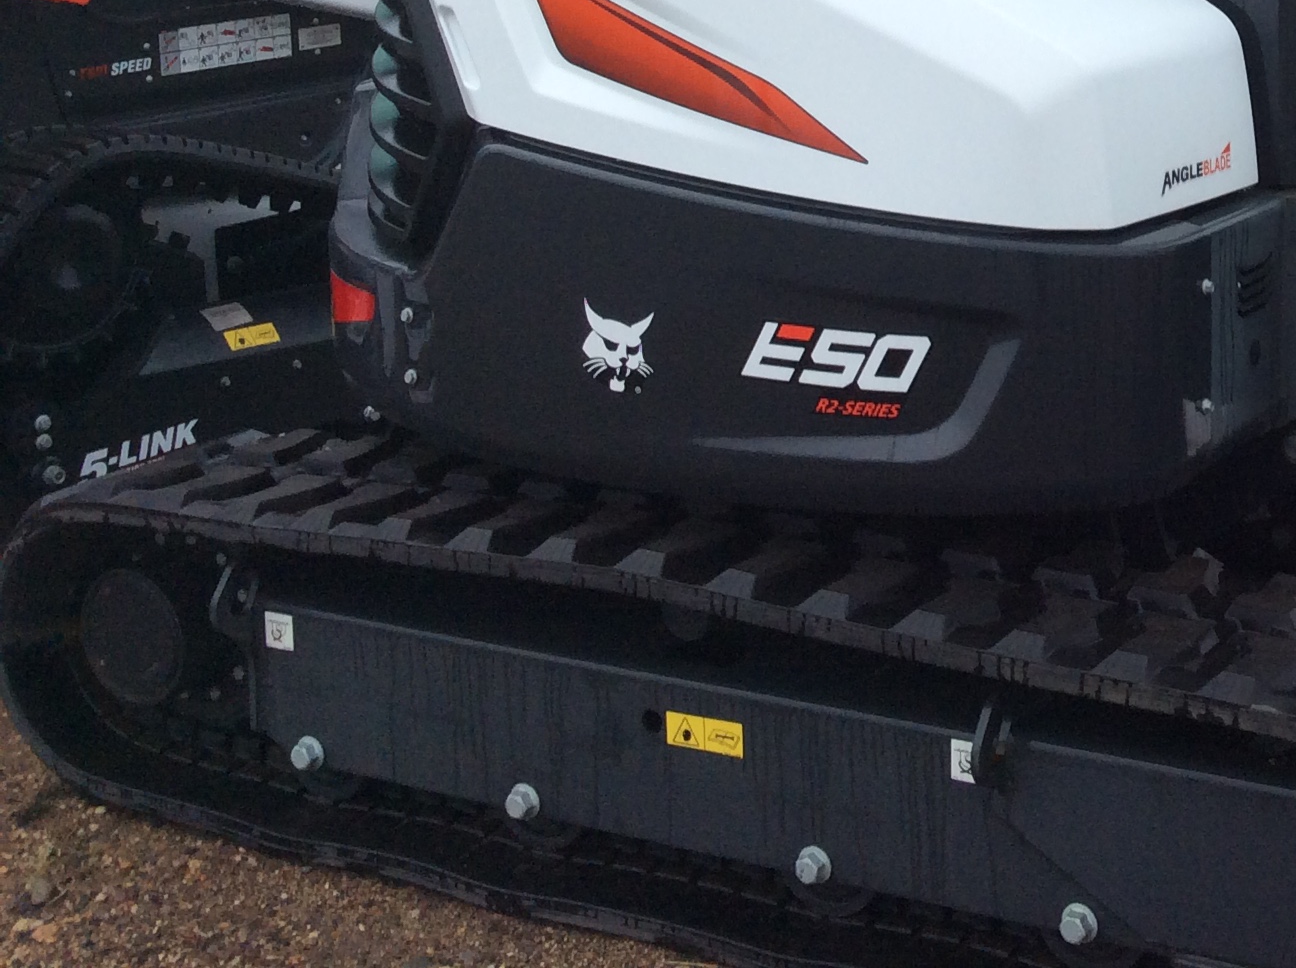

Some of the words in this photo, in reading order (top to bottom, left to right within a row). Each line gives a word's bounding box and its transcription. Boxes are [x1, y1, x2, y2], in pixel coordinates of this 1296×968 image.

[111, 57, 152, 76] SPEED
[741, 321, 931, 393] E50
[815, 397, 901, 419] R2-SERIES
[80, 418, 199, 478] 5-LINK
